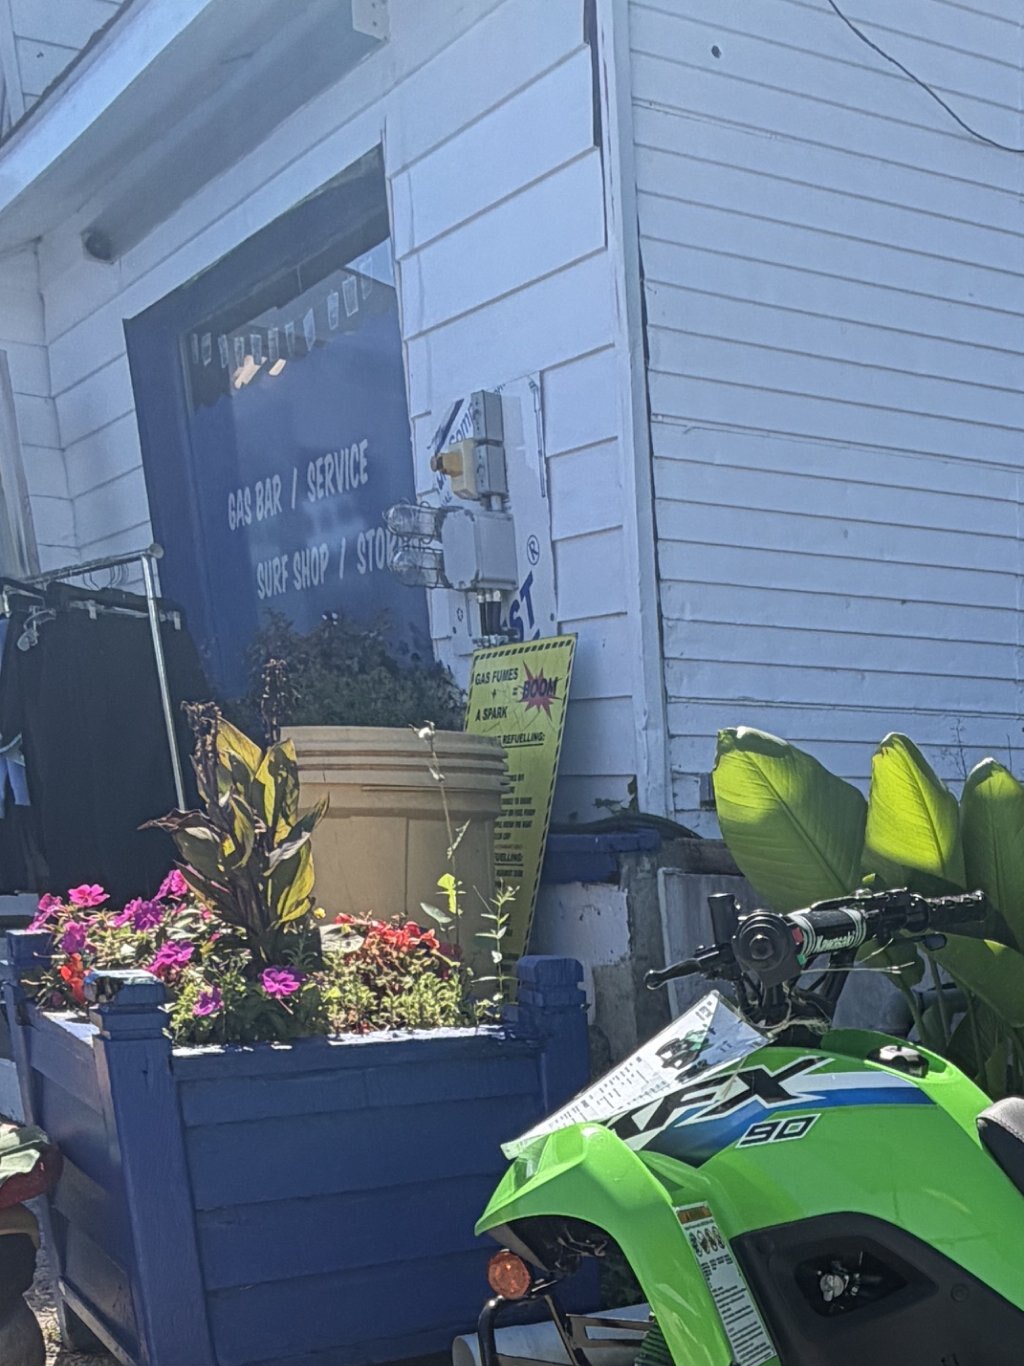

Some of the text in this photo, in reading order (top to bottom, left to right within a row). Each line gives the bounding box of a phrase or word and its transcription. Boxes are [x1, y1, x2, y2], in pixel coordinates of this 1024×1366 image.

[228, 438, 368, 531] GAS BAR / SERVICE
[257, 527, 402, 599] SURF SHOP / STOK
[475, 668, 518, 685] GAS FUMES
[523, 677, 558, 700] BOOM
[475, 706, 508, 721] A SPARK
[740, 1114, 820, 1145] 90
